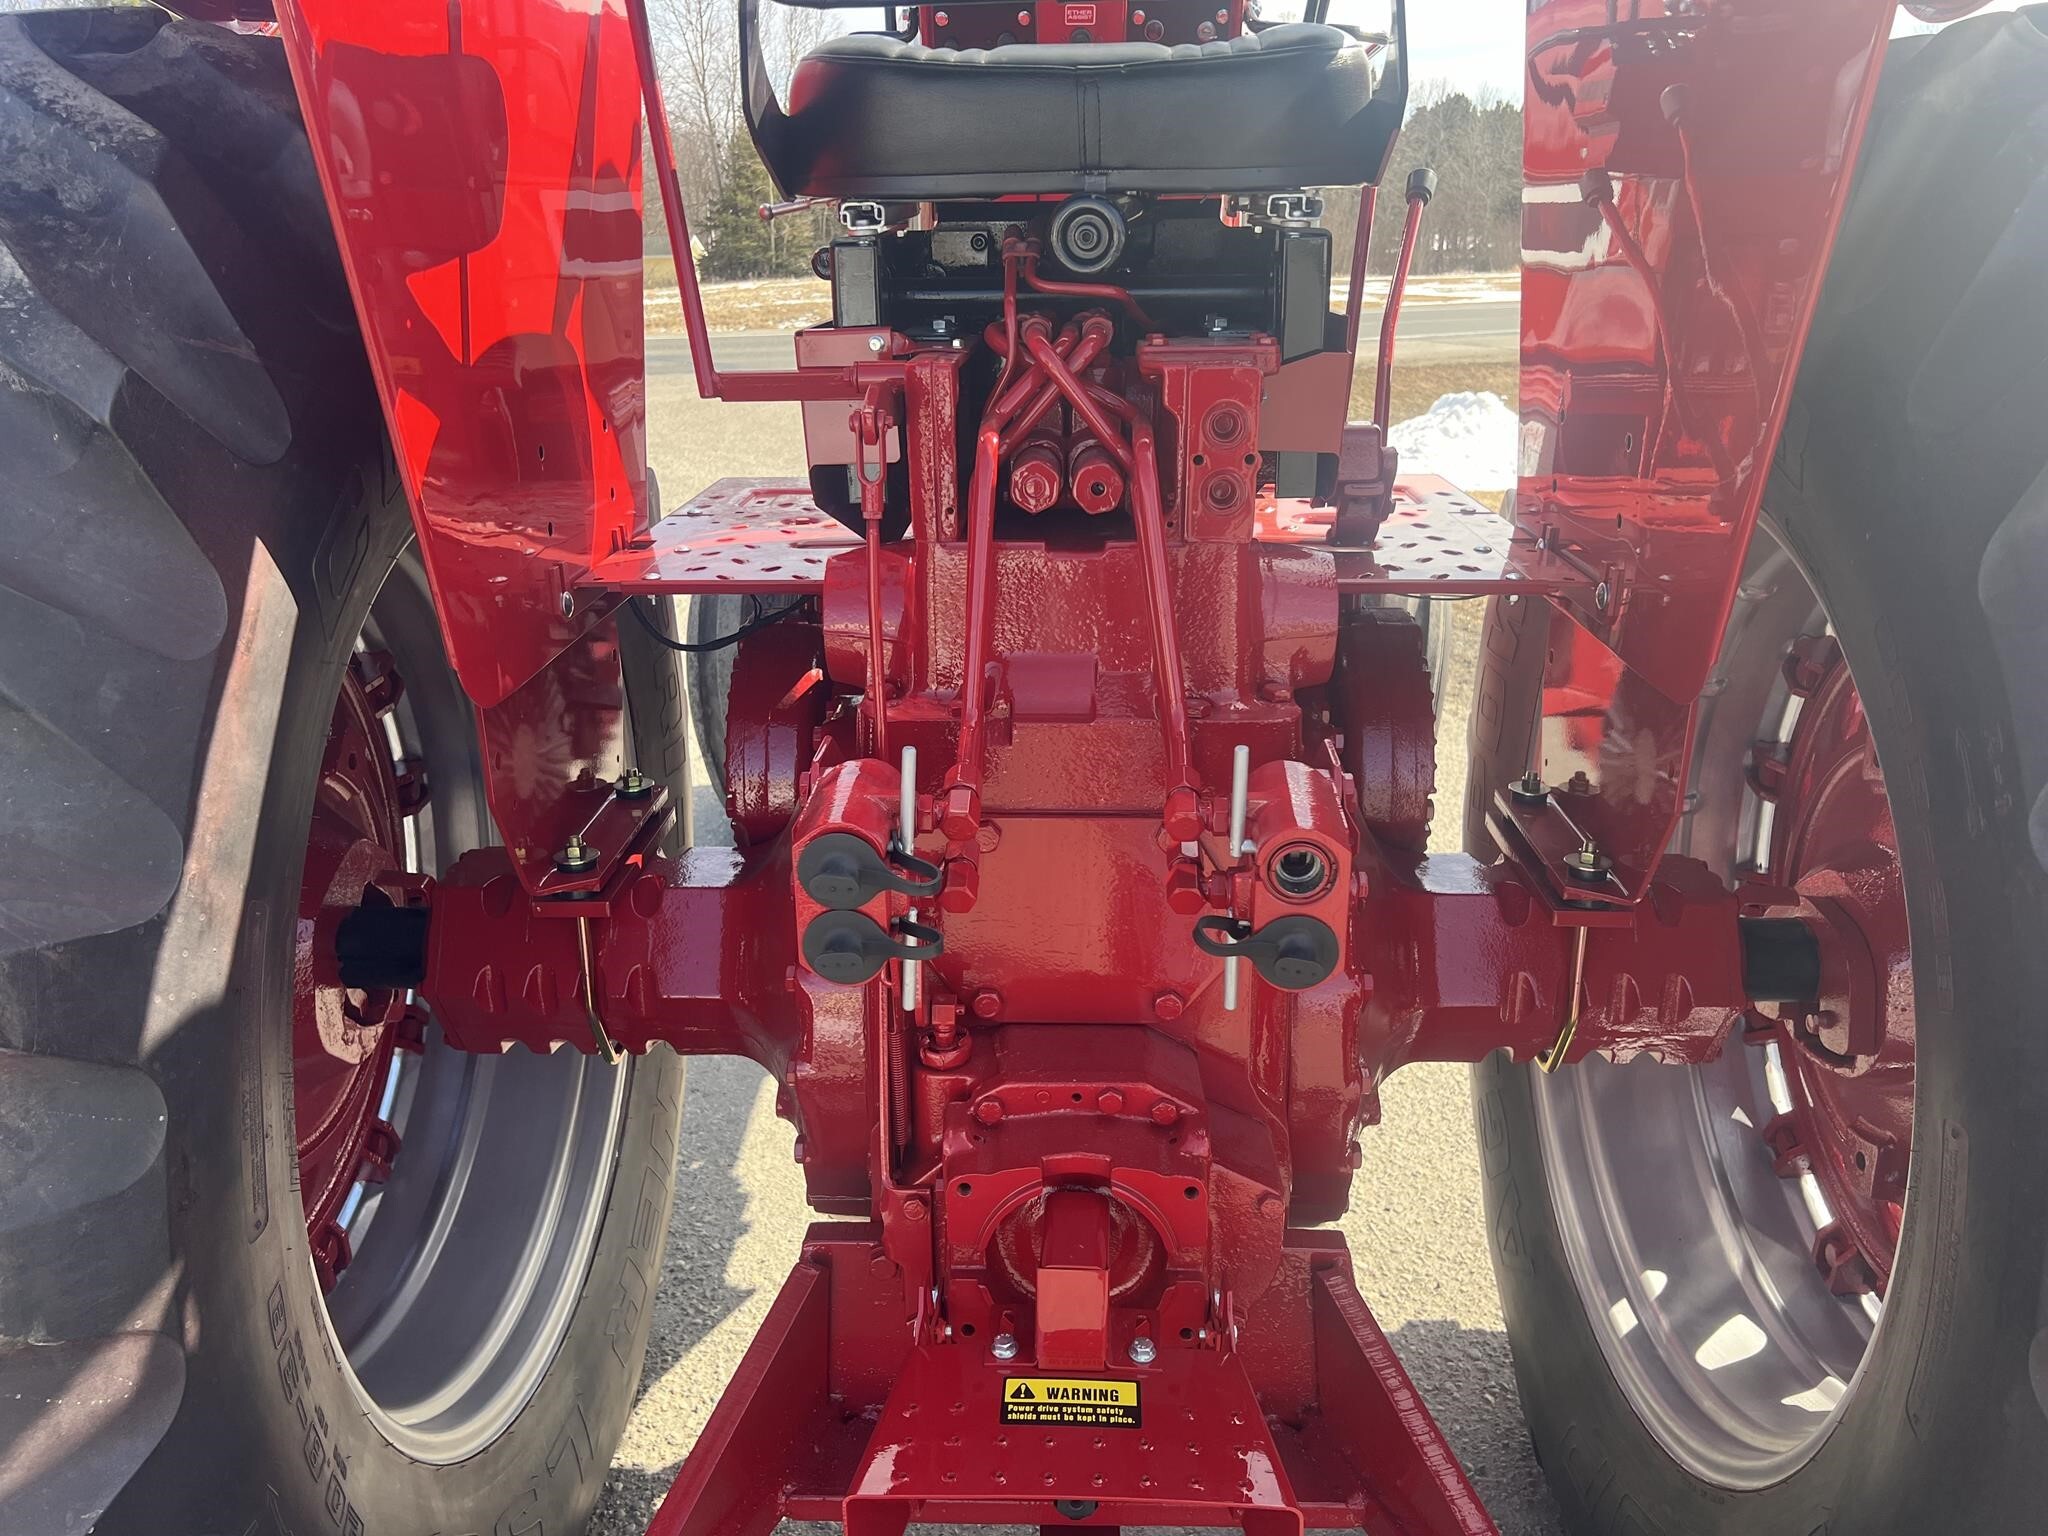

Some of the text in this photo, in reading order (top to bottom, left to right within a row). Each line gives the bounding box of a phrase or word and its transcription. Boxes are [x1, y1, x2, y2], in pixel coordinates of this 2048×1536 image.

[1047, 1387, 1119, 1402] WARNING
[1007, 1404, 1124, 1416] Power drive system safety
[1007, 1413, 1037, 1421] shields
[1040, 1413, 1061, 1421] must
[1064, 1413, 1074, 1421] be
[1077, 1414, 1096, 1423] kept
[1110, 1415, 1136, 1424] place.
